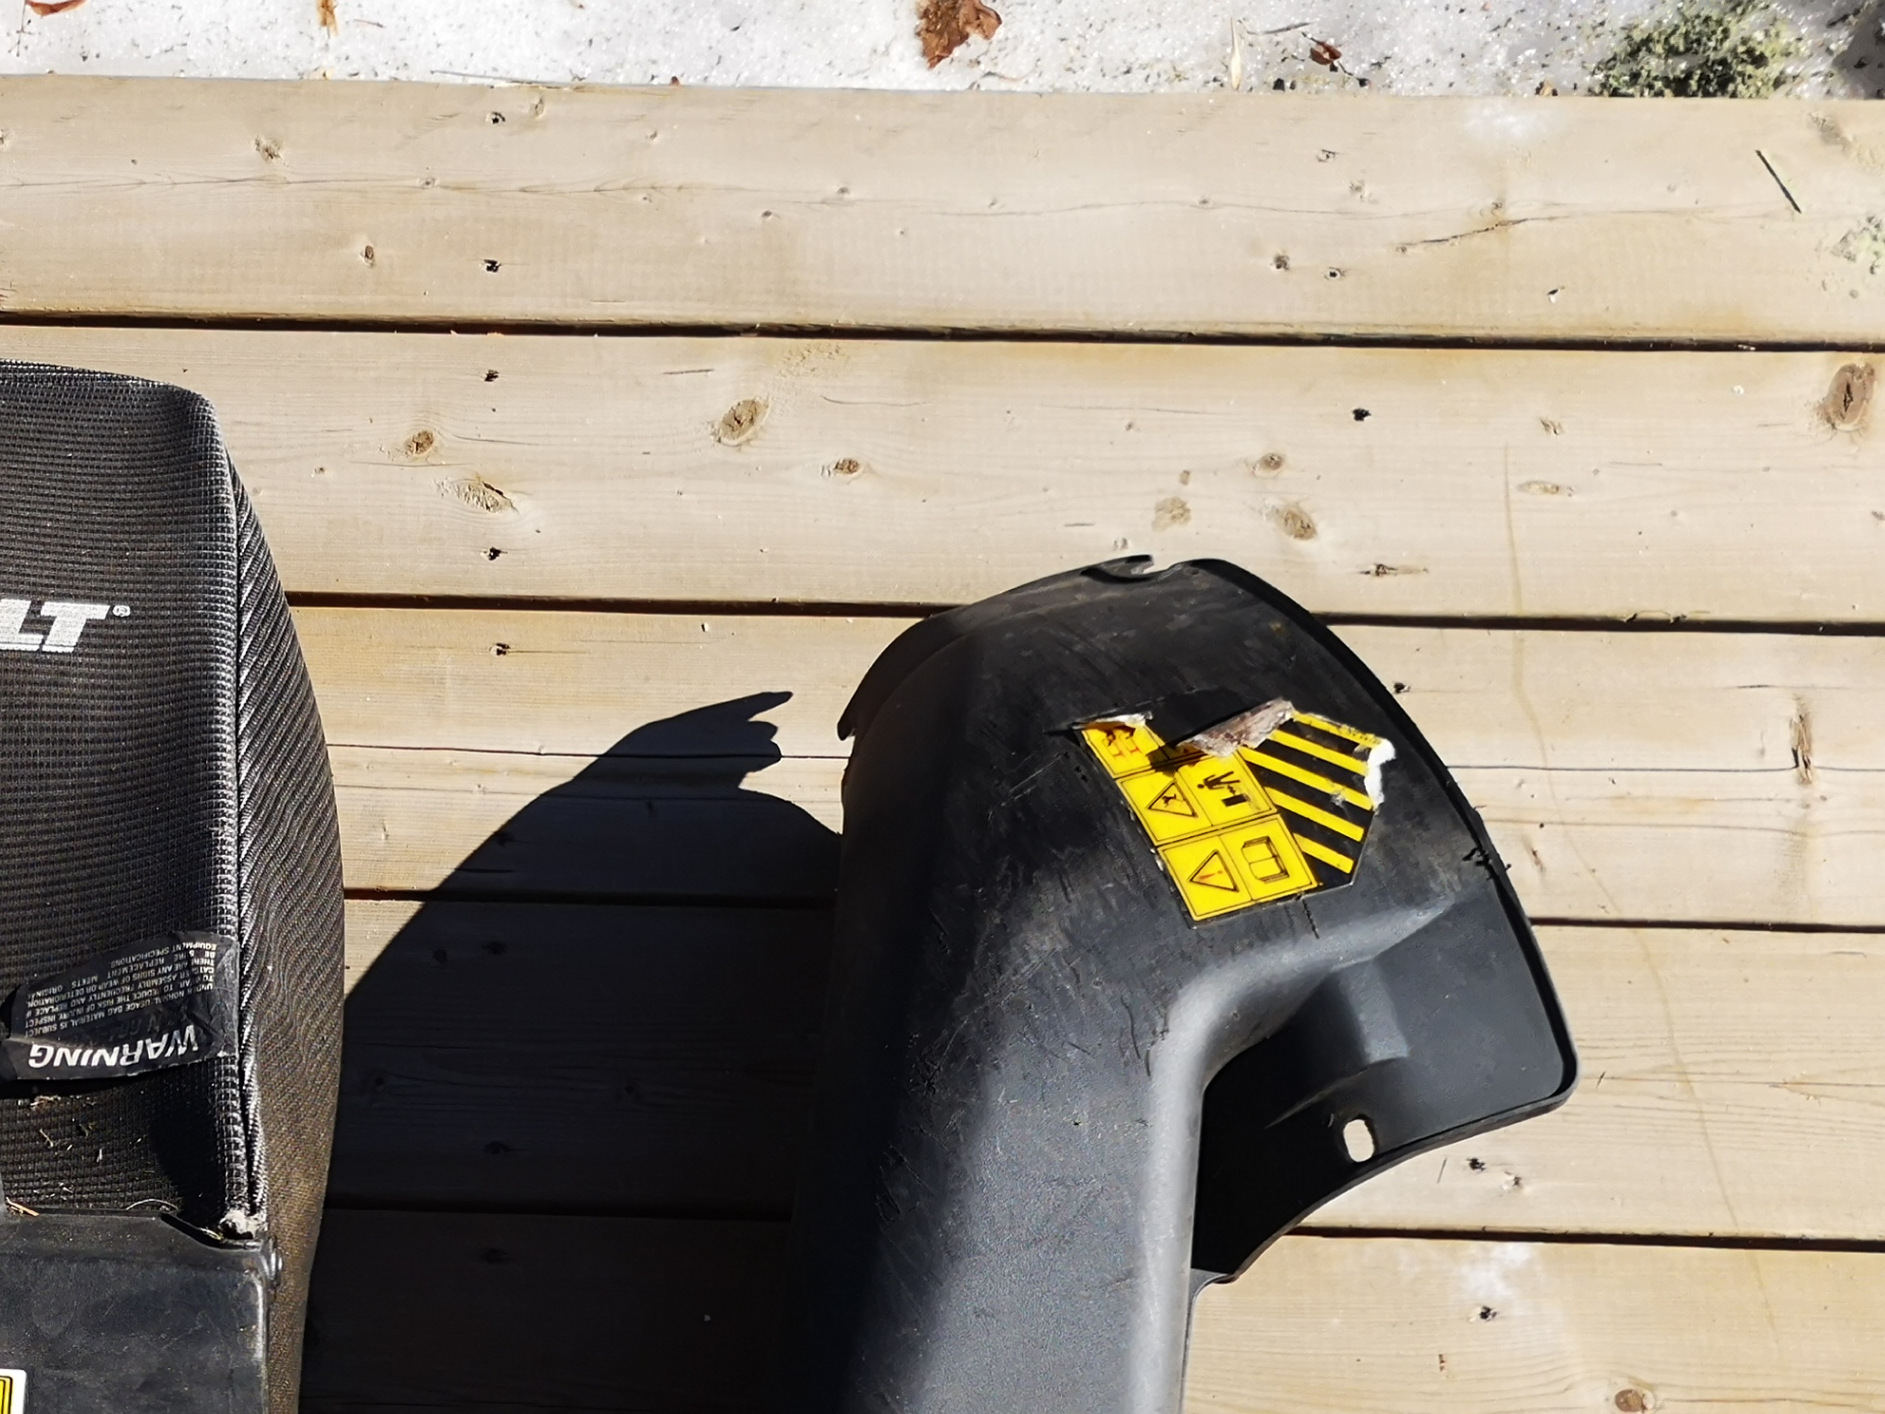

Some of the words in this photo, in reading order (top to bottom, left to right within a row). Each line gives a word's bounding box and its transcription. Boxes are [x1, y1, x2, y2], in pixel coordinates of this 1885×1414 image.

[174, 950, 194, 961] SRE
[108, 957, 164, 978] REPLACEMENT
[157, 965, 172, 975] ANY
[174, 961, 187, 971] ARE
[133, 969, 155, 980] SIGNS
[180, 966, 214, 979] CATCER
[72, 976, 97, 988] MEETS
[99, 979, 119, 989] WEAR
[138, 974, 177, 989] ASSEMBLY
[86, 985, 96, 993] OR
[89, 984, 134, 1001] FREQUENTLY
[164, 984, 173, 992] TO
[187, 983, 213, 993] UNDR
[71, 997, 86, 1006] AND
[98, 999, 114, 1008] RISK
[116, 995, 129, 1003] THE
[35, 1003, 67, 1015] REPLACE
[86, 1004, 95, 1012] OF
[108, 1006, 122, 1015] BAG
[126, 1000, 150, 1011] USAGE
[25, 1015, 56, 1028] INSPECT
[70, 1011, 104, 1027] MATERIAL
[25, 1024, 57, 1037] SUBJECT
[28, 1024, 198, 1069] WARNING
